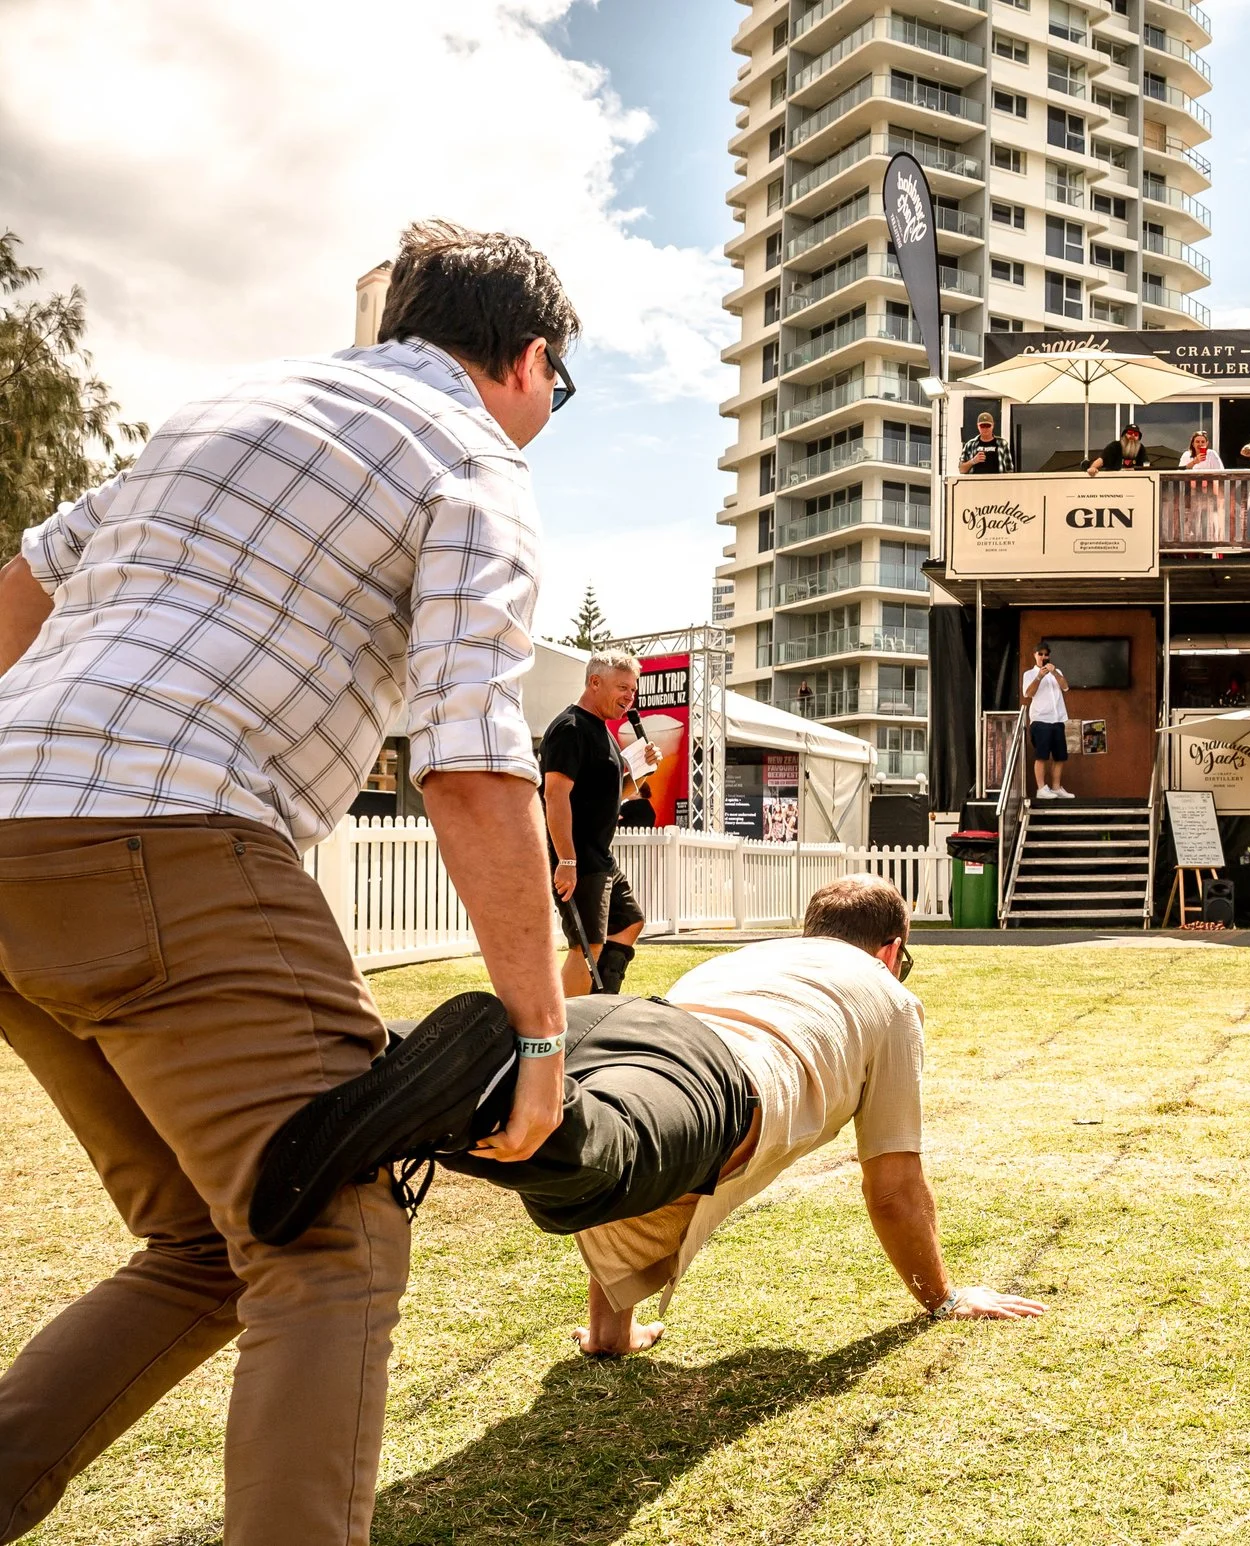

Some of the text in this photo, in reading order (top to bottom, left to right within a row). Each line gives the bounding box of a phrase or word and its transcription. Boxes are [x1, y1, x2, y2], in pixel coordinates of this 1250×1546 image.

[1176, 346, 1235, 356] CRAFT
[962, 500, 1036, 530] Granddad
[1066, 508, 1134, 528] GIN
[976, 516, 1018, 539] Jack's
[638, 671, 687, 696] WIN A TRIP
[638, 692, 686, 708] TO DUNEDIN, NZ
[768, 756, 784, 764] NEW
[1203, 751, 1246, 774] Jack's
